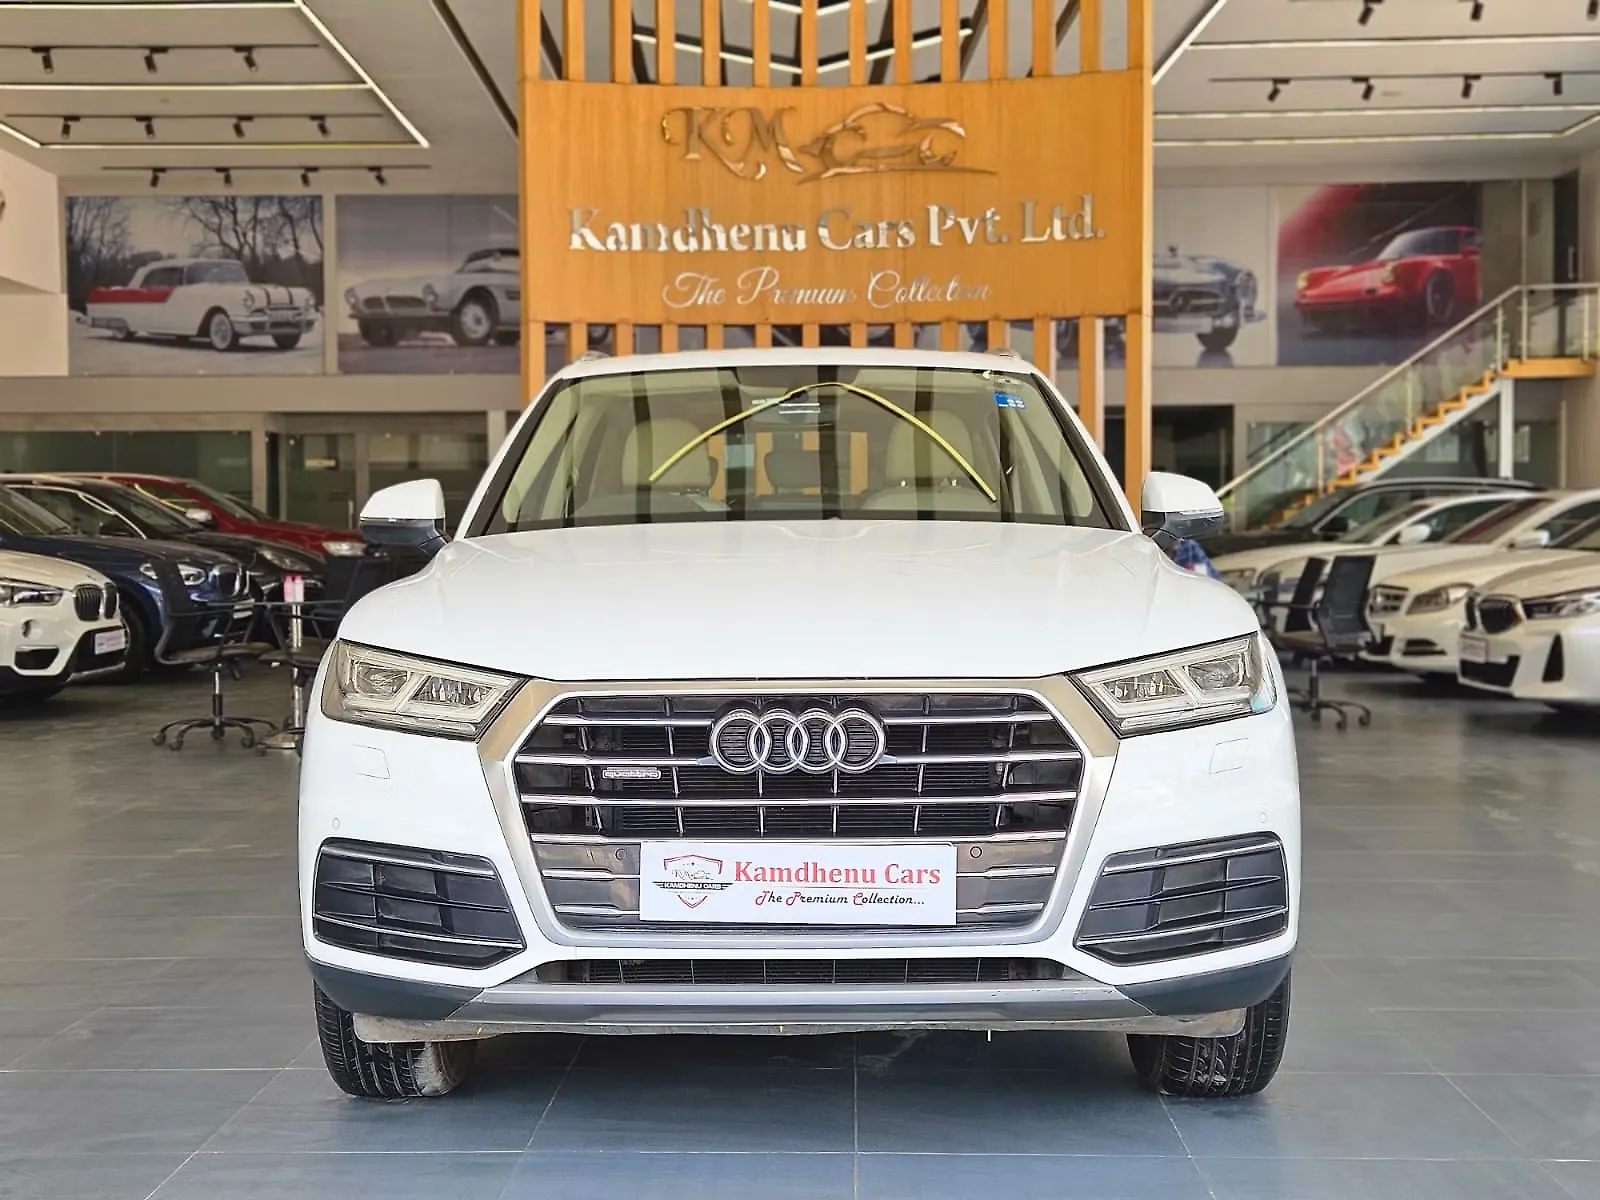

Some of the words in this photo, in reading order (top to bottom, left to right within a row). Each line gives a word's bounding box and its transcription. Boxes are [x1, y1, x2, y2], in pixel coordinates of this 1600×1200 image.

[568, 203, 807, 253] Kamdhenu
[817, 207, 916, 250] Cars
[926, 203, 1010, 247] Pvt.
[1020, 191, 1107, 244] Ltd.
[661, 271, 726, 309] The
[734, 861, 876, 884] Kamdhenu
[884, 863, 941, 884] Cars
[755, 891, 782, 906] The
[785, 891, 849, 906] Premium
[852, 892, 925, 906] Collection...
